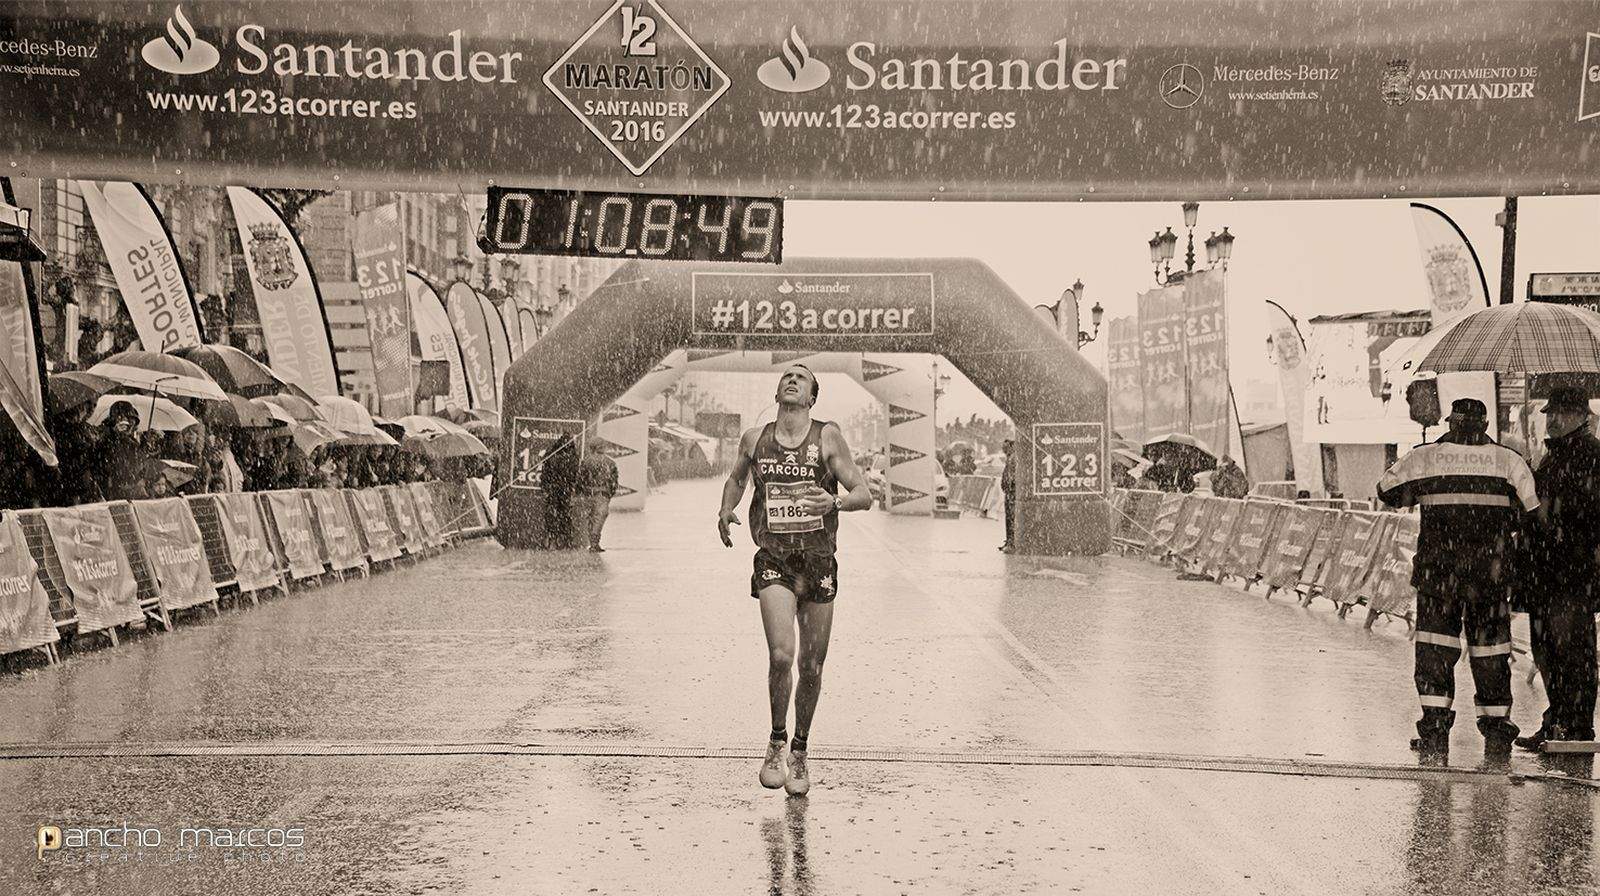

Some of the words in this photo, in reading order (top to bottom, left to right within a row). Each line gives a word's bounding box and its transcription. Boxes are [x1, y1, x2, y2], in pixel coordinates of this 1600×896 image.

[236, 24, 523, 83] Santander
[846, 37, 1127, 92] Santander
[1213, 64, 1339, 81] Mercedes-Benz
[1417, 67, 1517, 81] AYUNTAMIENTO
[1519, 66, 1538, 78] DE
[565, 58, 713, 92] MARATÓN
[1415, 83, 1535, 101] SANTANDER
[147, 88, 417, 120] www.123acorrer.es
[584, 100, 689, 118] SANTANDER
[759, 104, 1017, 130] www.123acorrer.es
[610, 120, 666, 142] 2016
[795, 280, 851, 294] Santander
[1054, 434, 1099, 444] Santander
[760, 464, 816, 478] CARCOBA
